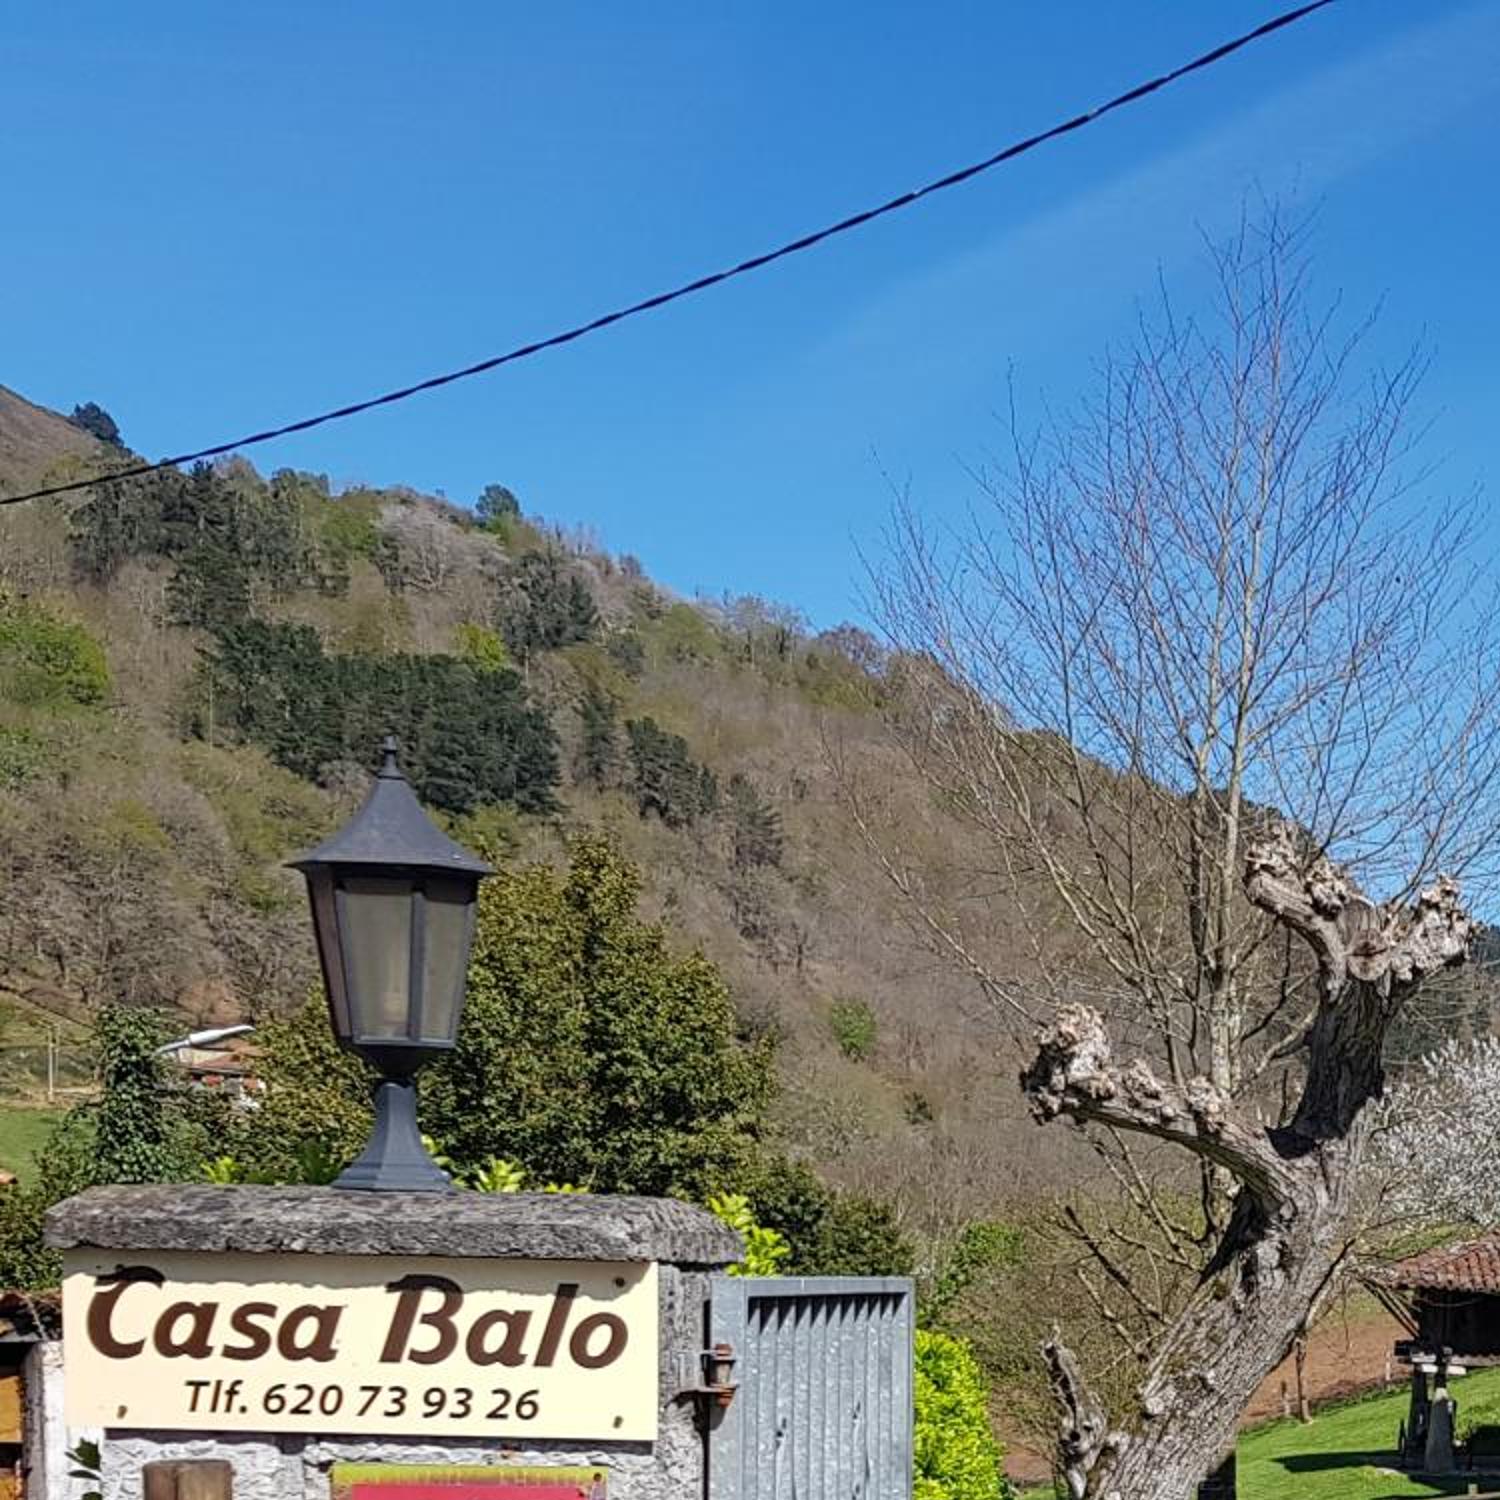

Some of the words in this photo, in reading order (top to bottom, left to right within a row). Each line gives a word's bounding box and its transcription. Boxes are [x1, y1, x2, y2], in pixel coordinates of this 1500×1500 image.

[86, 1264, 346, 1363] Casa
[378, 1272, 630, 1369] Balo
[185, 1379, 248, 1413] Tlf.
[263, 1383, 343, 1416] 620
[358, 1385, 407, 1417] 73
[422, 1387, 473, 1419] 93
[486, 1388, 540, 1420] 26
